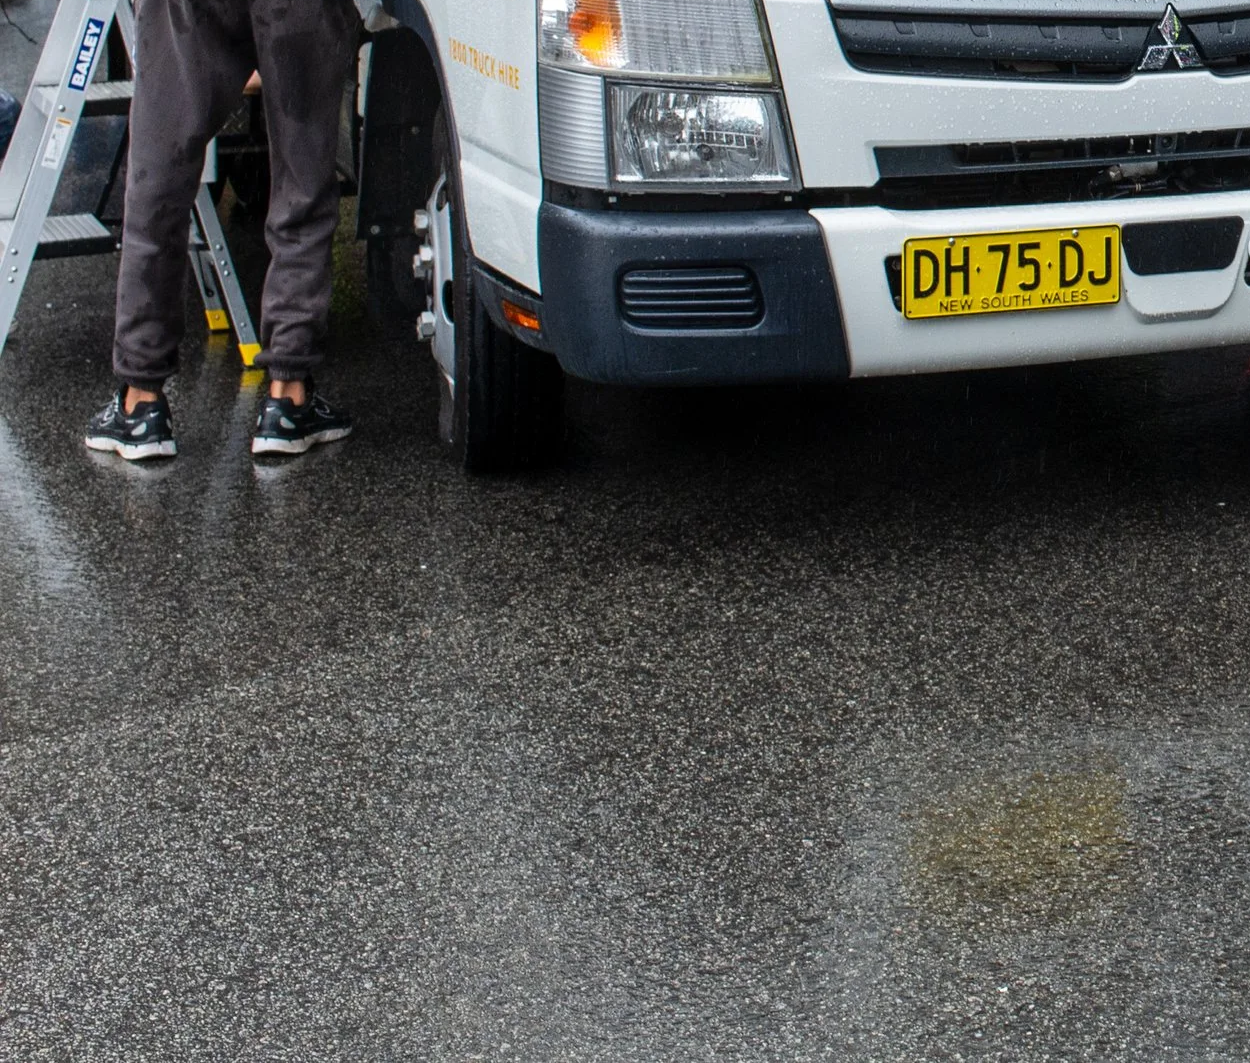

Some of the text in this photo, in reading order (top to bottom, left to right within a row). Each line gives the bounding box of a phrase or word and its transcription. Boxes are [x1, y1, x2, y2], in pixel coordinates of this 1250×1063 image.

[70, 21, 101, 88] BAILEY
[449, 37, 520, 90] 1800 TRUCK HIRE
[913, 236, 1112, 299] DH 75 DJ
[939, 289, 1089, 313] NEW SOUTH WALES
